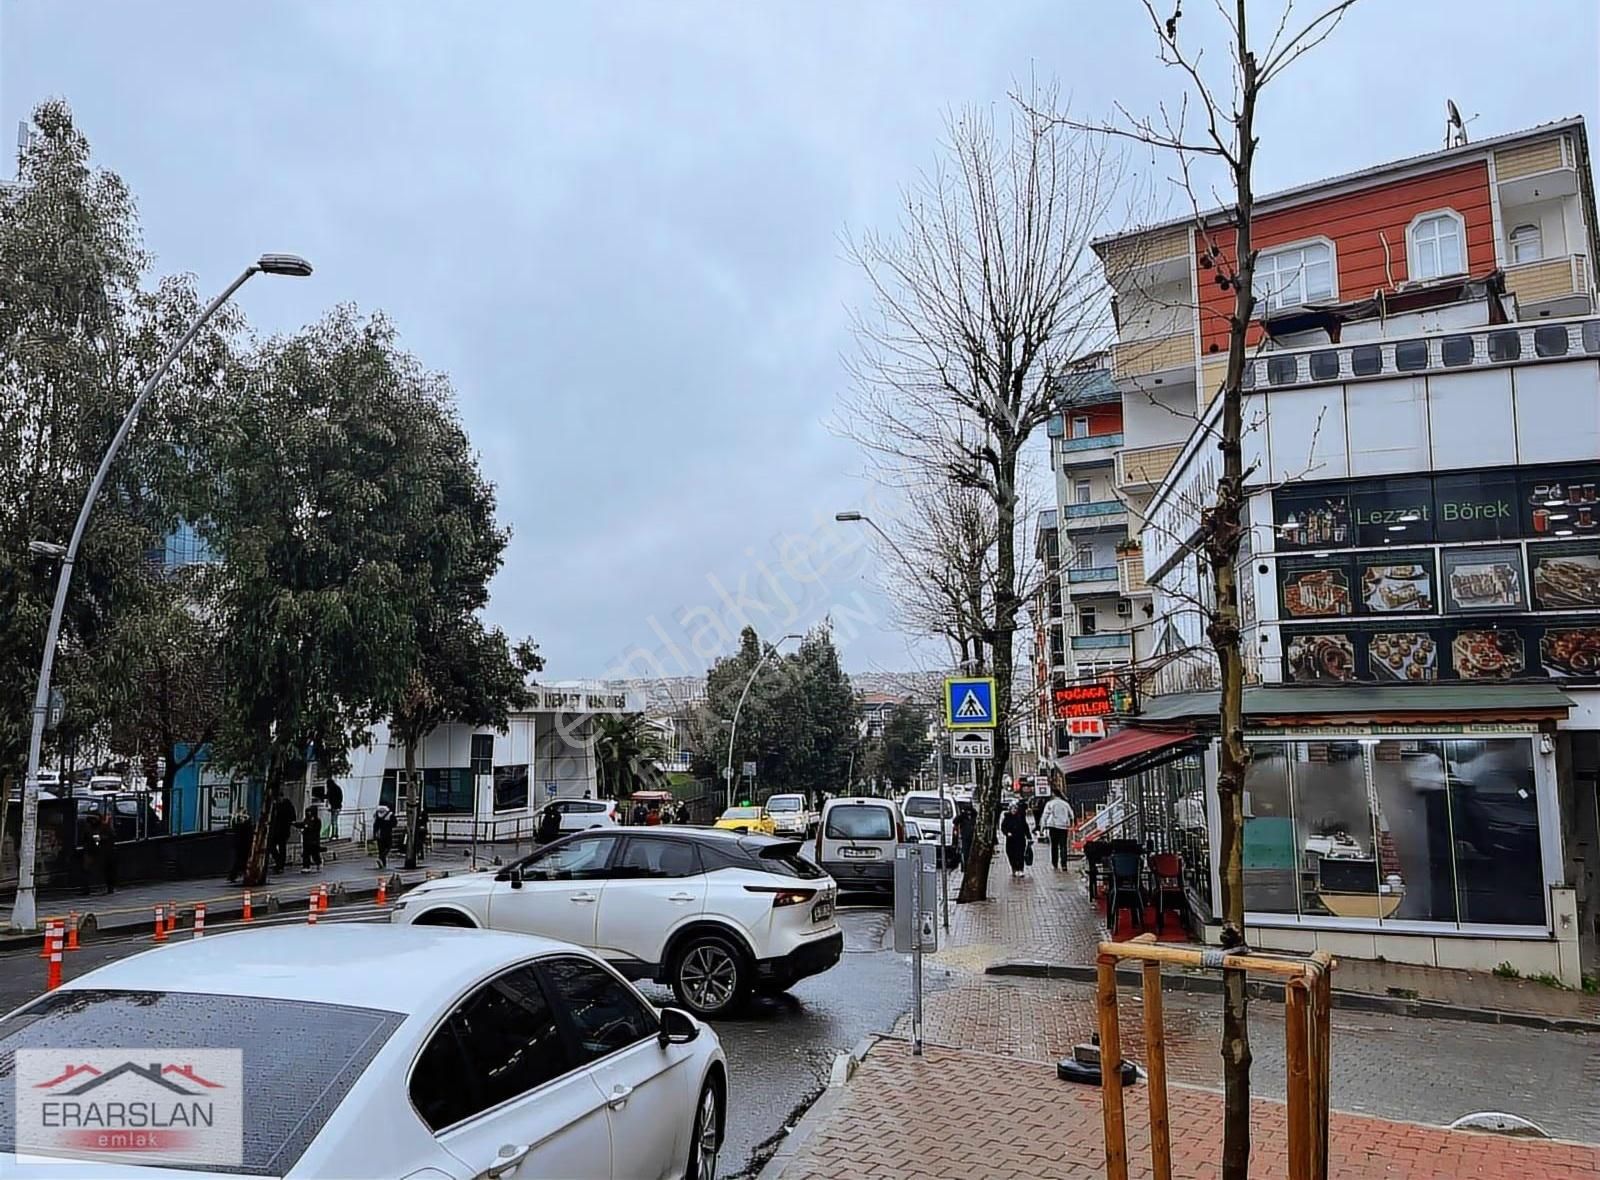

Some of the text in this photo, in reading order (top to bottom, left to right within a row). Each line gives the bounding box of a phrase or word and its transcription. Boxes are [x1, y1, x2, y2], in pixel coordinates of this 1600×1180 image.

[1357, 500, 1511, 525] Lezzet Börek
[954, 743, 991, 755] KASİS
